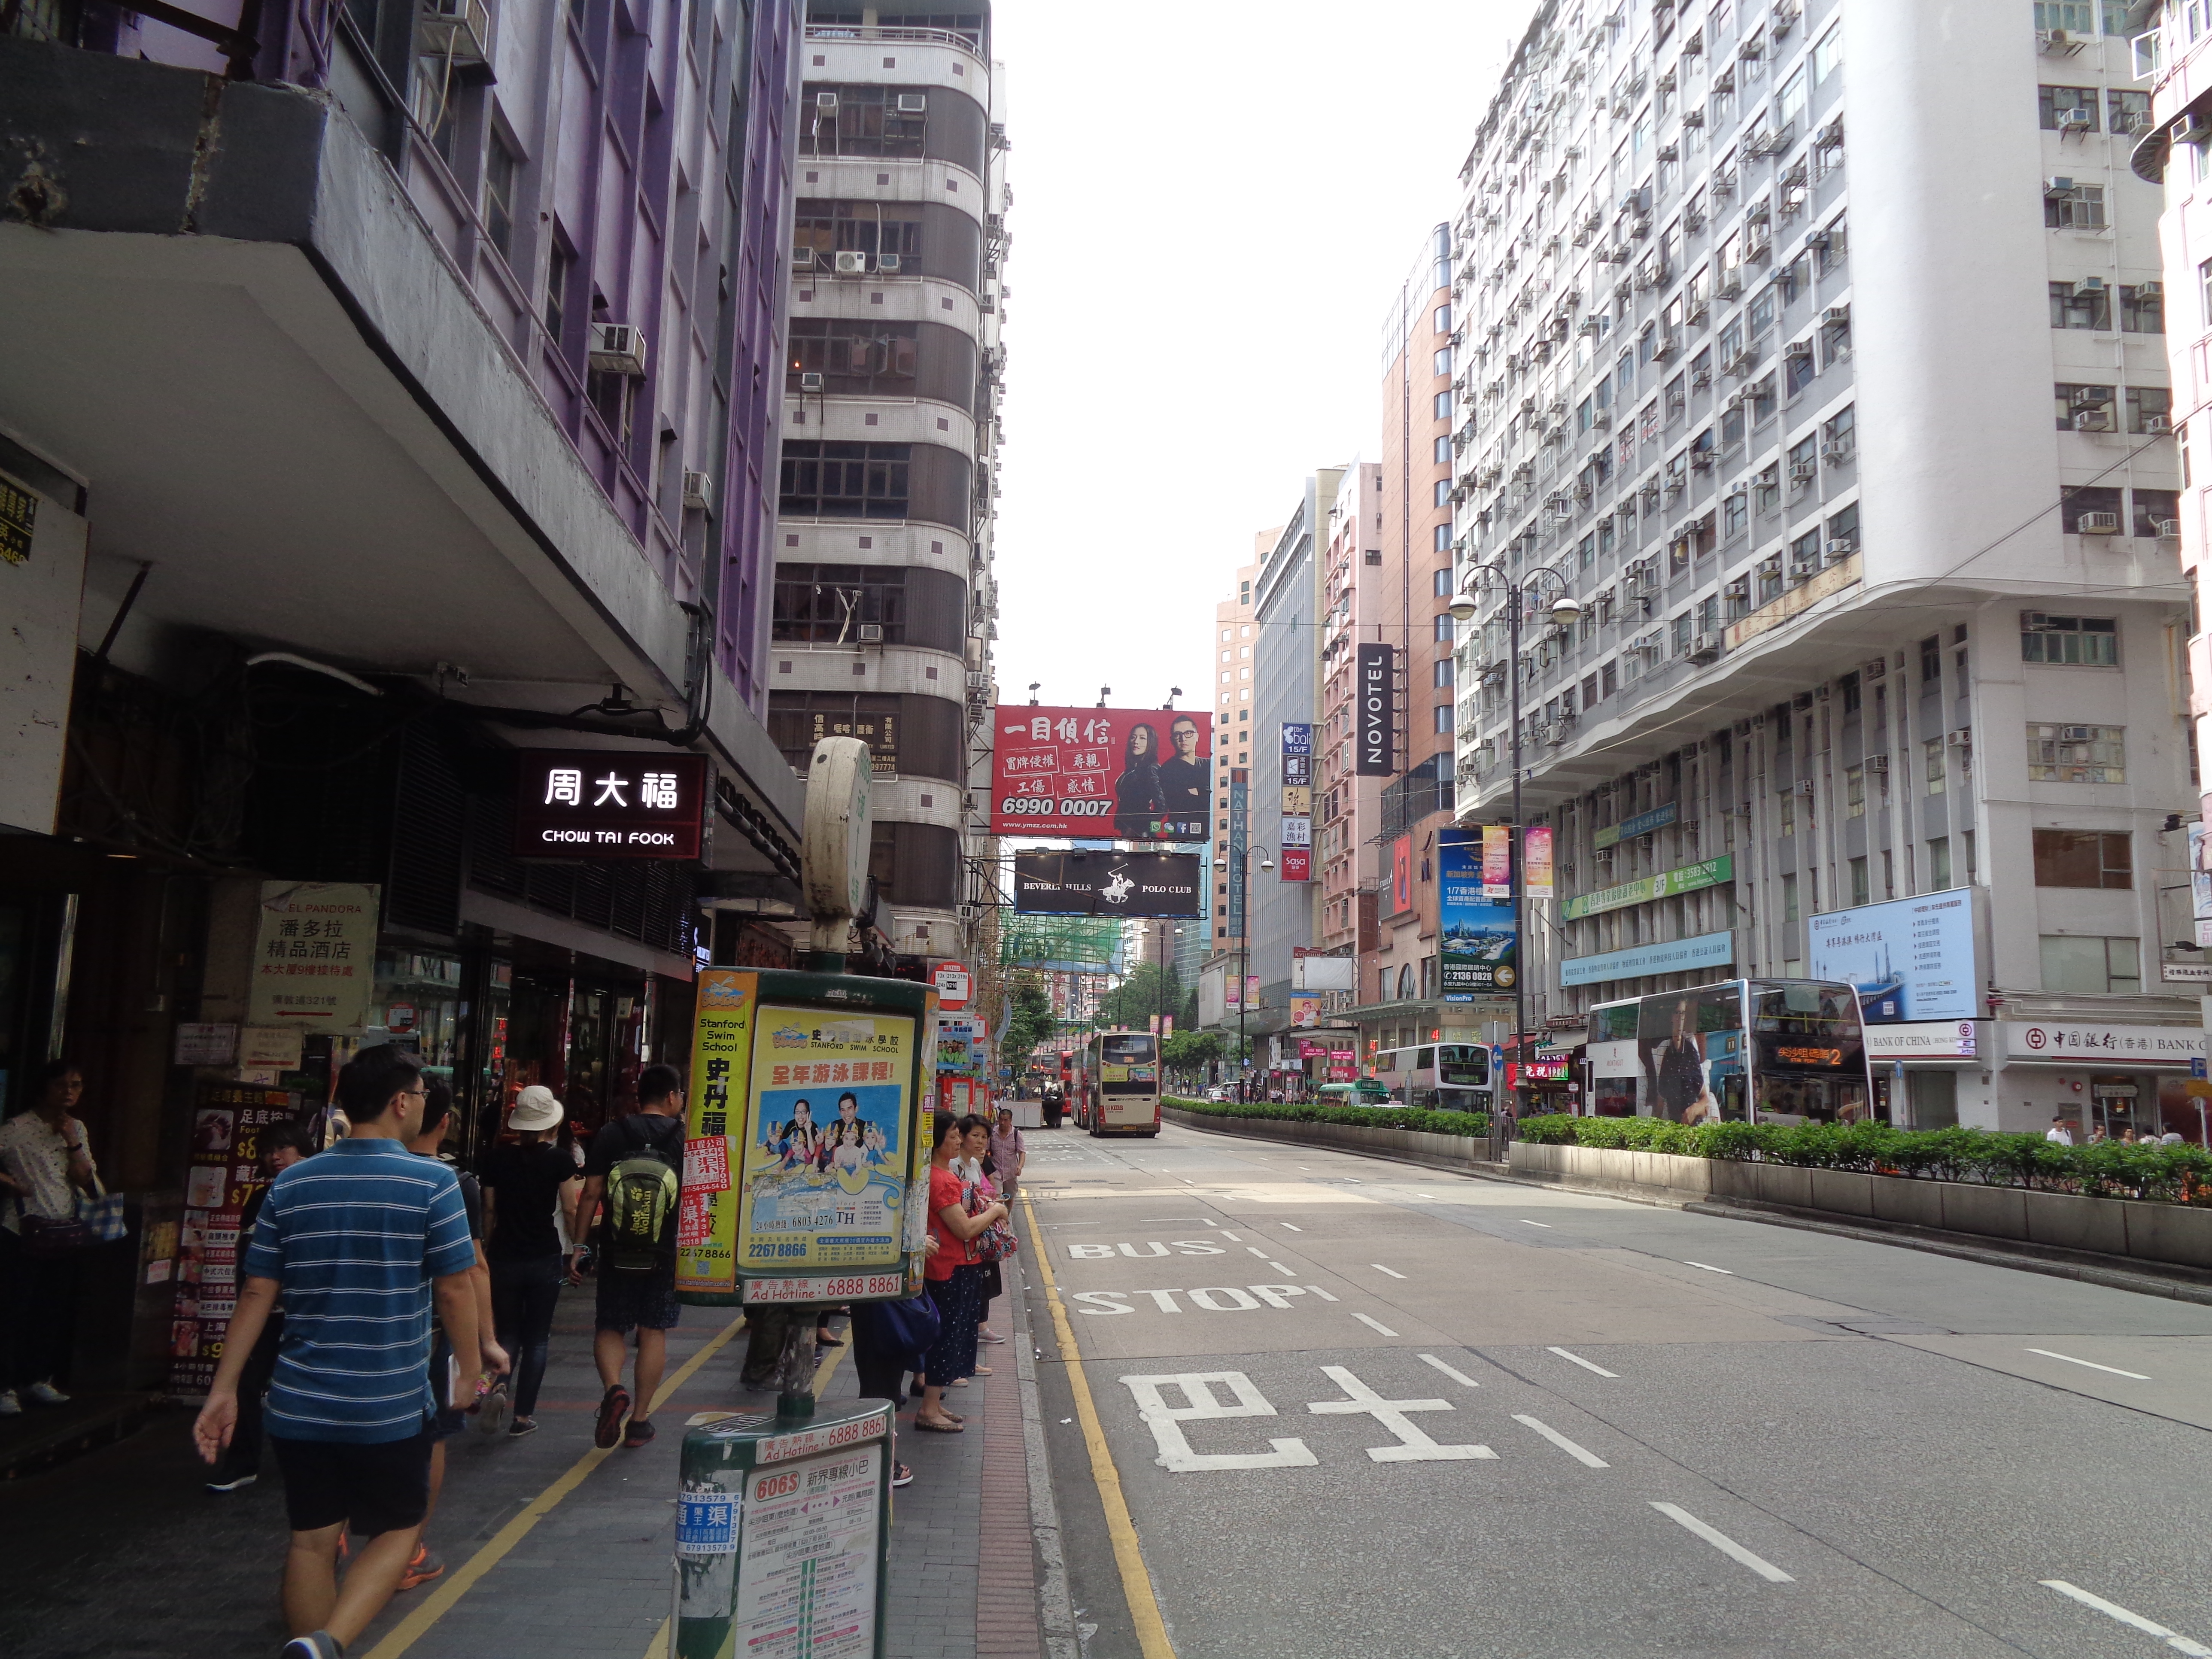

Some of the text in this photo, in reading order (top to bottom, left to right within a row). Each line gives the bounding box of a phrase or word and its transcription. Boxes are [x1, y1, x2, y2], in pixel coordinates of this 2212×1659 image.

[1368, 656, 1382, 763] NOVOTEL
[1294, 733, 1310, 745] bali
[1073, 754, 1100, 769] 尋親
[544, 769, 678, 808] 周大福
[1017, 779, 1045, 794] 工傷
[1067, 777, 1095, 793] 感情
[1002, 798, 1112, 816] 6990 0007
[1003, 822, 1068, 830] www.ymzz.com.hk
[1234, 790, 1244, 851] NATHAN
[542, 830, 675, 845] CHOW TAI FOOK
[1286, 832, 1305, 842] 漁村
[1686, 867, 1701, 879] 3583
[1702, 862, 1717, 875] 2612
[1024, 882, 1191, 893] BEVERLY HILLS POLO CLUB
[1233, 863, 1243, 915] HOTEL
[1655, 879, 1665, 893] 3/F
[306, 904, 362, 913] PANDORA
[280, 919, 343, 937] 潘多拉
[267, 940, 352, 959] 精品酒店
[261, 963, 353, 976] 本大廈9樓接待處
[1452, 972, 1492, 981] 2136 0828
[700, 1019, 744, 1029] Stanford
[707, 1031, 735, 1040] Swim
[812, 1030, 898, 1045] 史泳學校
[1874, 1037, 1893, 1046] BANK
[1895, 1037, 1904, 1046] OF
[1906, 1036, 1931, 1045] CHINA
[702, 1042, 737, 1051] School
[2157, 1039, 2195, 1050] BANK
[1778, 1047, 1829, 1059] 尖沙咀碼頭
[1831, 1049, 1841, 1064] 2
[772, 1062, 894, 1085] 全年游泳課程!
[717, 1147, 727, 1189] 64337000
[684, 1183, 720, 1193] 67-54-54-54
[639, 1190, 651, 1235] Wolfskin
[630, 1210, 641, 1234] Jack
[793, 1216, 811, 1227] 6803
[814, 1215, 833, 1226] 4276
[1067, 1240, 1227, 1259] BUS
[751, 1280, 808, 1291] 廣告熱線
[827, 1276, 899, 1296] 6888 8861
[751, 1289, 815, 1300] Ad Hotline
[1072, 1285, 1308, 1316] STOP
[1118, 1365, 1501, 1472] 巴士
[829, 1416, 885, 1446] 6888 8861
[764, 1433, 814, 1451] 廣告熱線
[764, 1443, 819, 1462] Ad Hotline
[807, 1459, 868, 1487] 新界專線小巴
[757, 1474, 798, 1499] 606S
[680, 1494, 726, 1502] 7913579
[707, 1506, 728, 1527] 渠
[730, 1495, 739, 1550] 67913579
